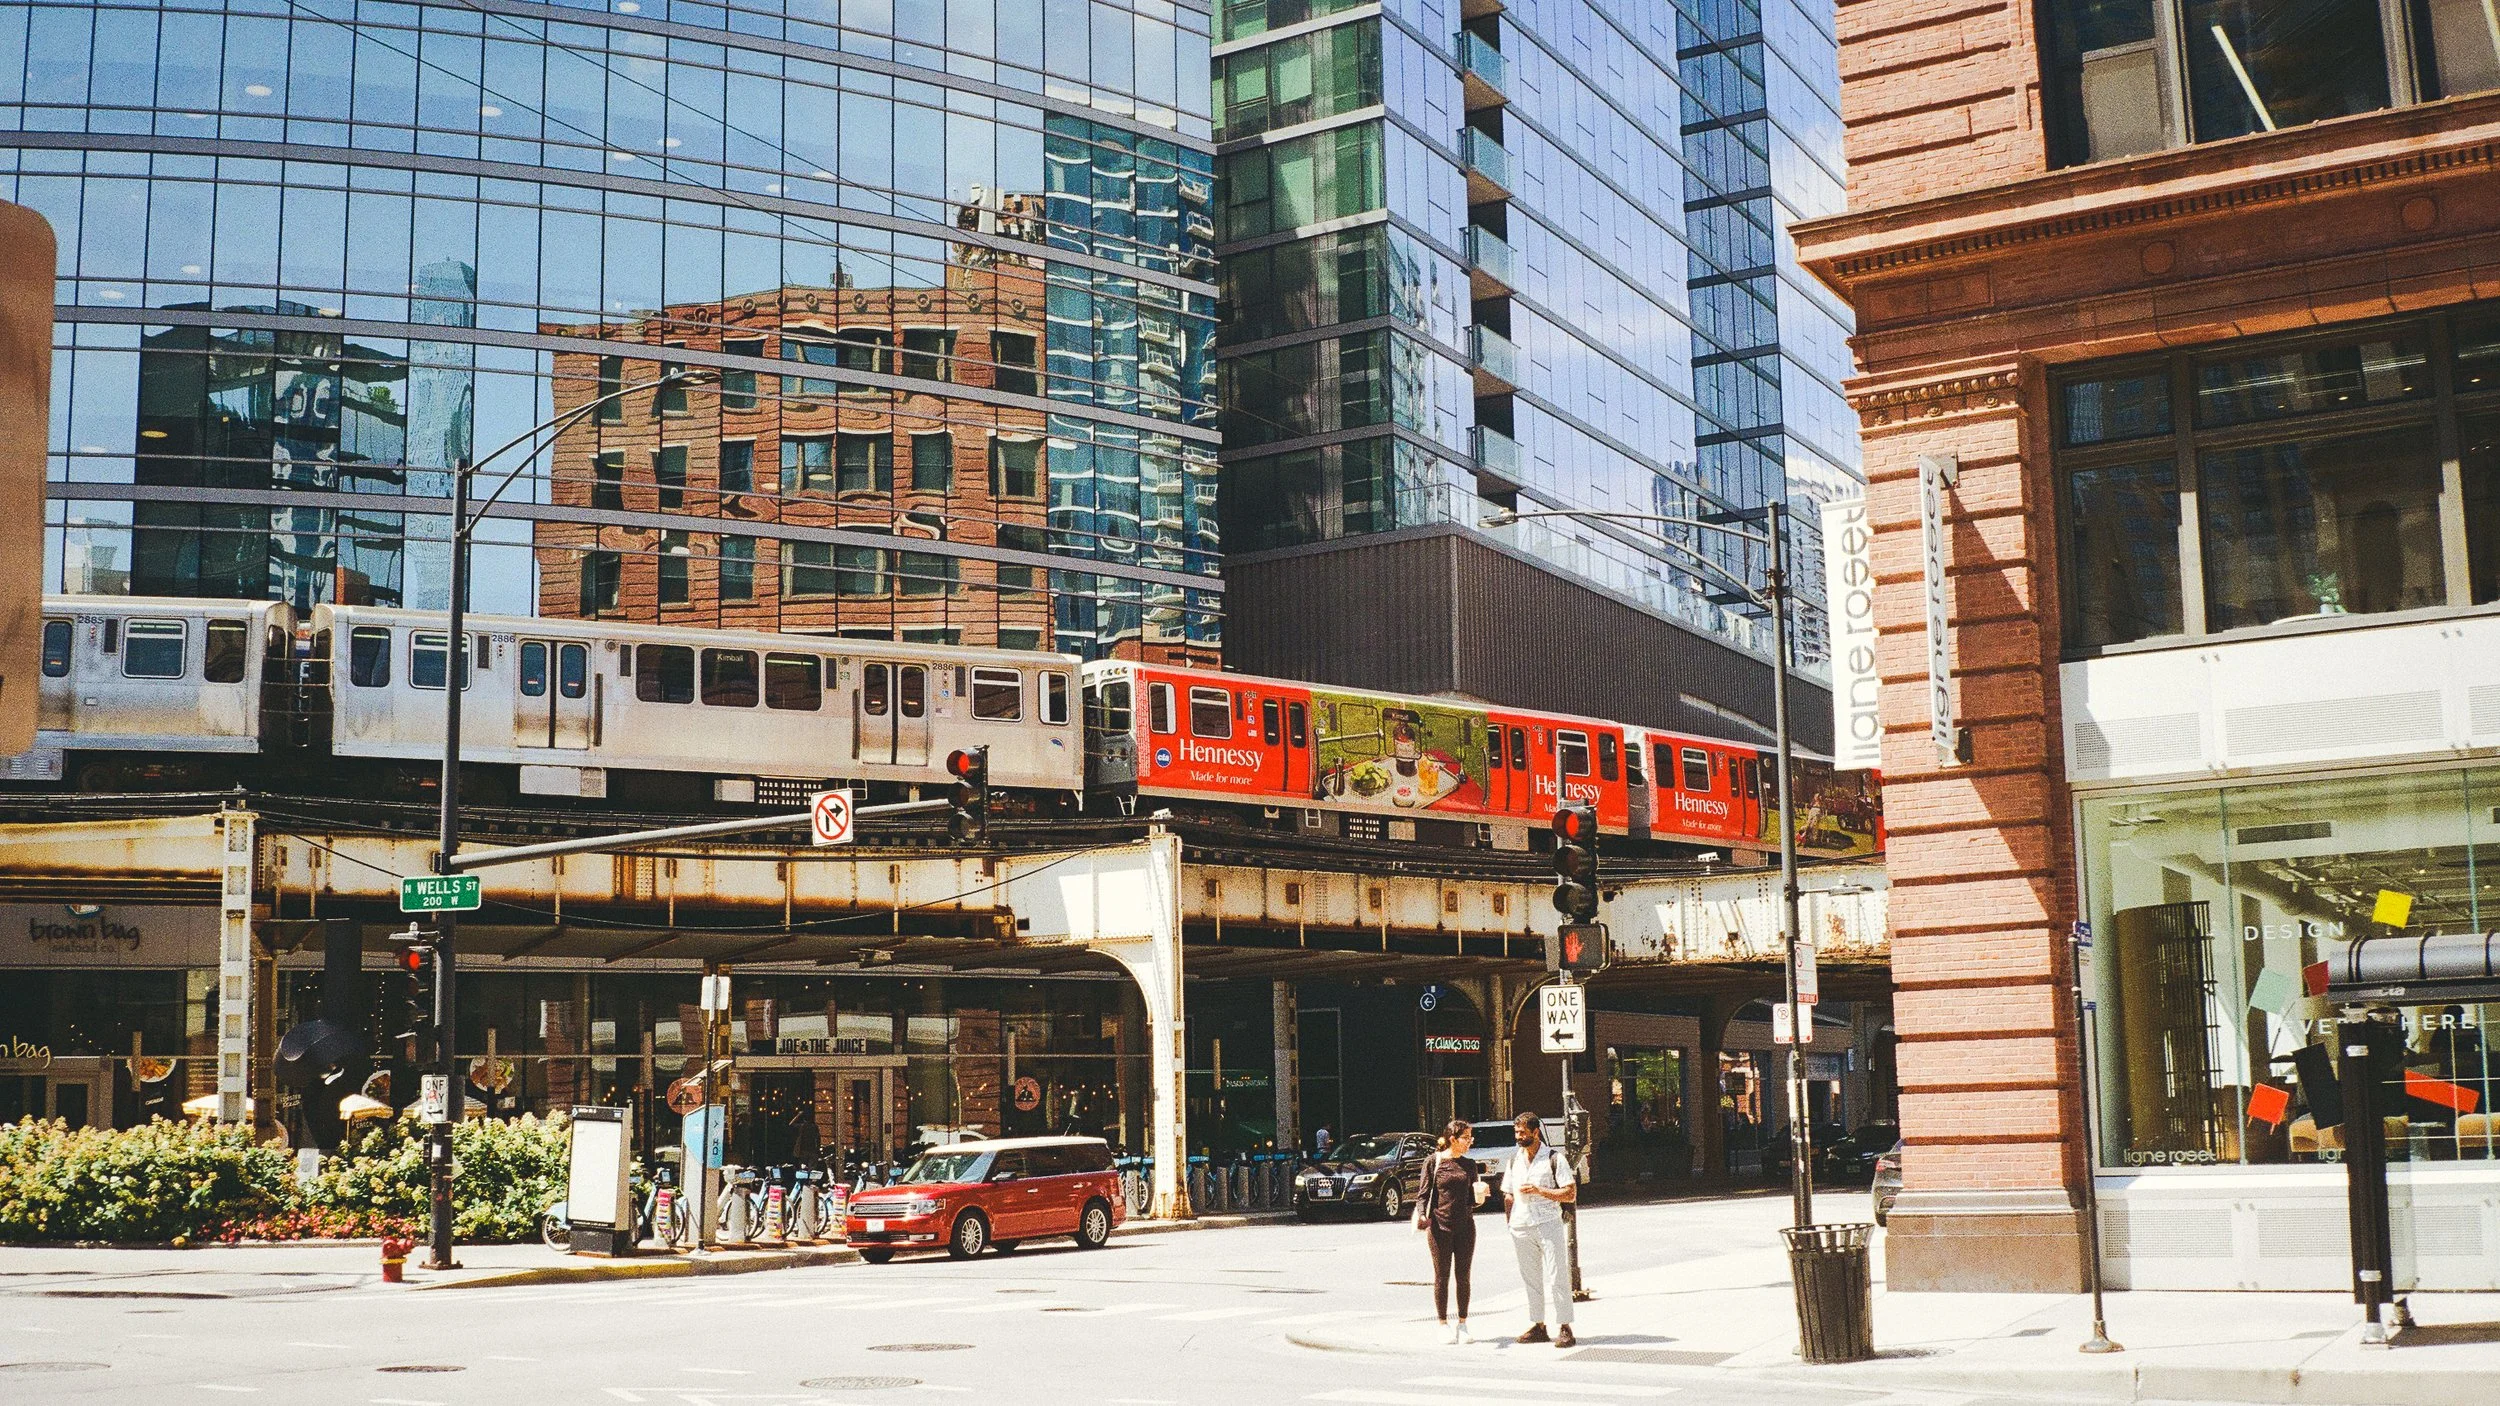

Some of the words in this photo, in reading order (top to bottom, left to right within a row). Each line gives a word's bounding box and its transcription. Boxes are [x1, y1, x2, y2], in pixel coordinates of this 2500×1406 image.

[1840, 506, 1873, 635] roset
[491, 634, 516, 643] 2886
[1934, 614, 1949, 738] ligne
[1180, 738, 1263, 772] Hennessy
[1190, 770, 1214, 782] Made
[1215, 771, 1228, 784] for
[1229, 775, 1253, 785] more
[1535, 774, 1602, 804] Henessy
[1543, 803, 1558, 813] Ma
[1674, 791, 1729, 820] Hennessy
[405, 884, 412, 893] N
[417, 880, 460, 895] WELLS
[465, 881, 477, 891] ST
[423, 896, 442, 907] 200
[451, 896, 459, 905] W
[29, 917, 97, 942] brown
[101, 916, 140, 951] bag
[2244, 921, 2344, 941] DESIGN
[1547, 991, 1579, 1007] ONE
[1546, 1009, 1579, 1025] WAY
[13, 1035, 51, 1069] bag
[833, 1038, 865, 1053] JUICE
[2123, 1149, 2166, 1166] ligne
[2168, 1148, 2217, 1162] roset
[2317, 1148, 2342, 1164] lig
